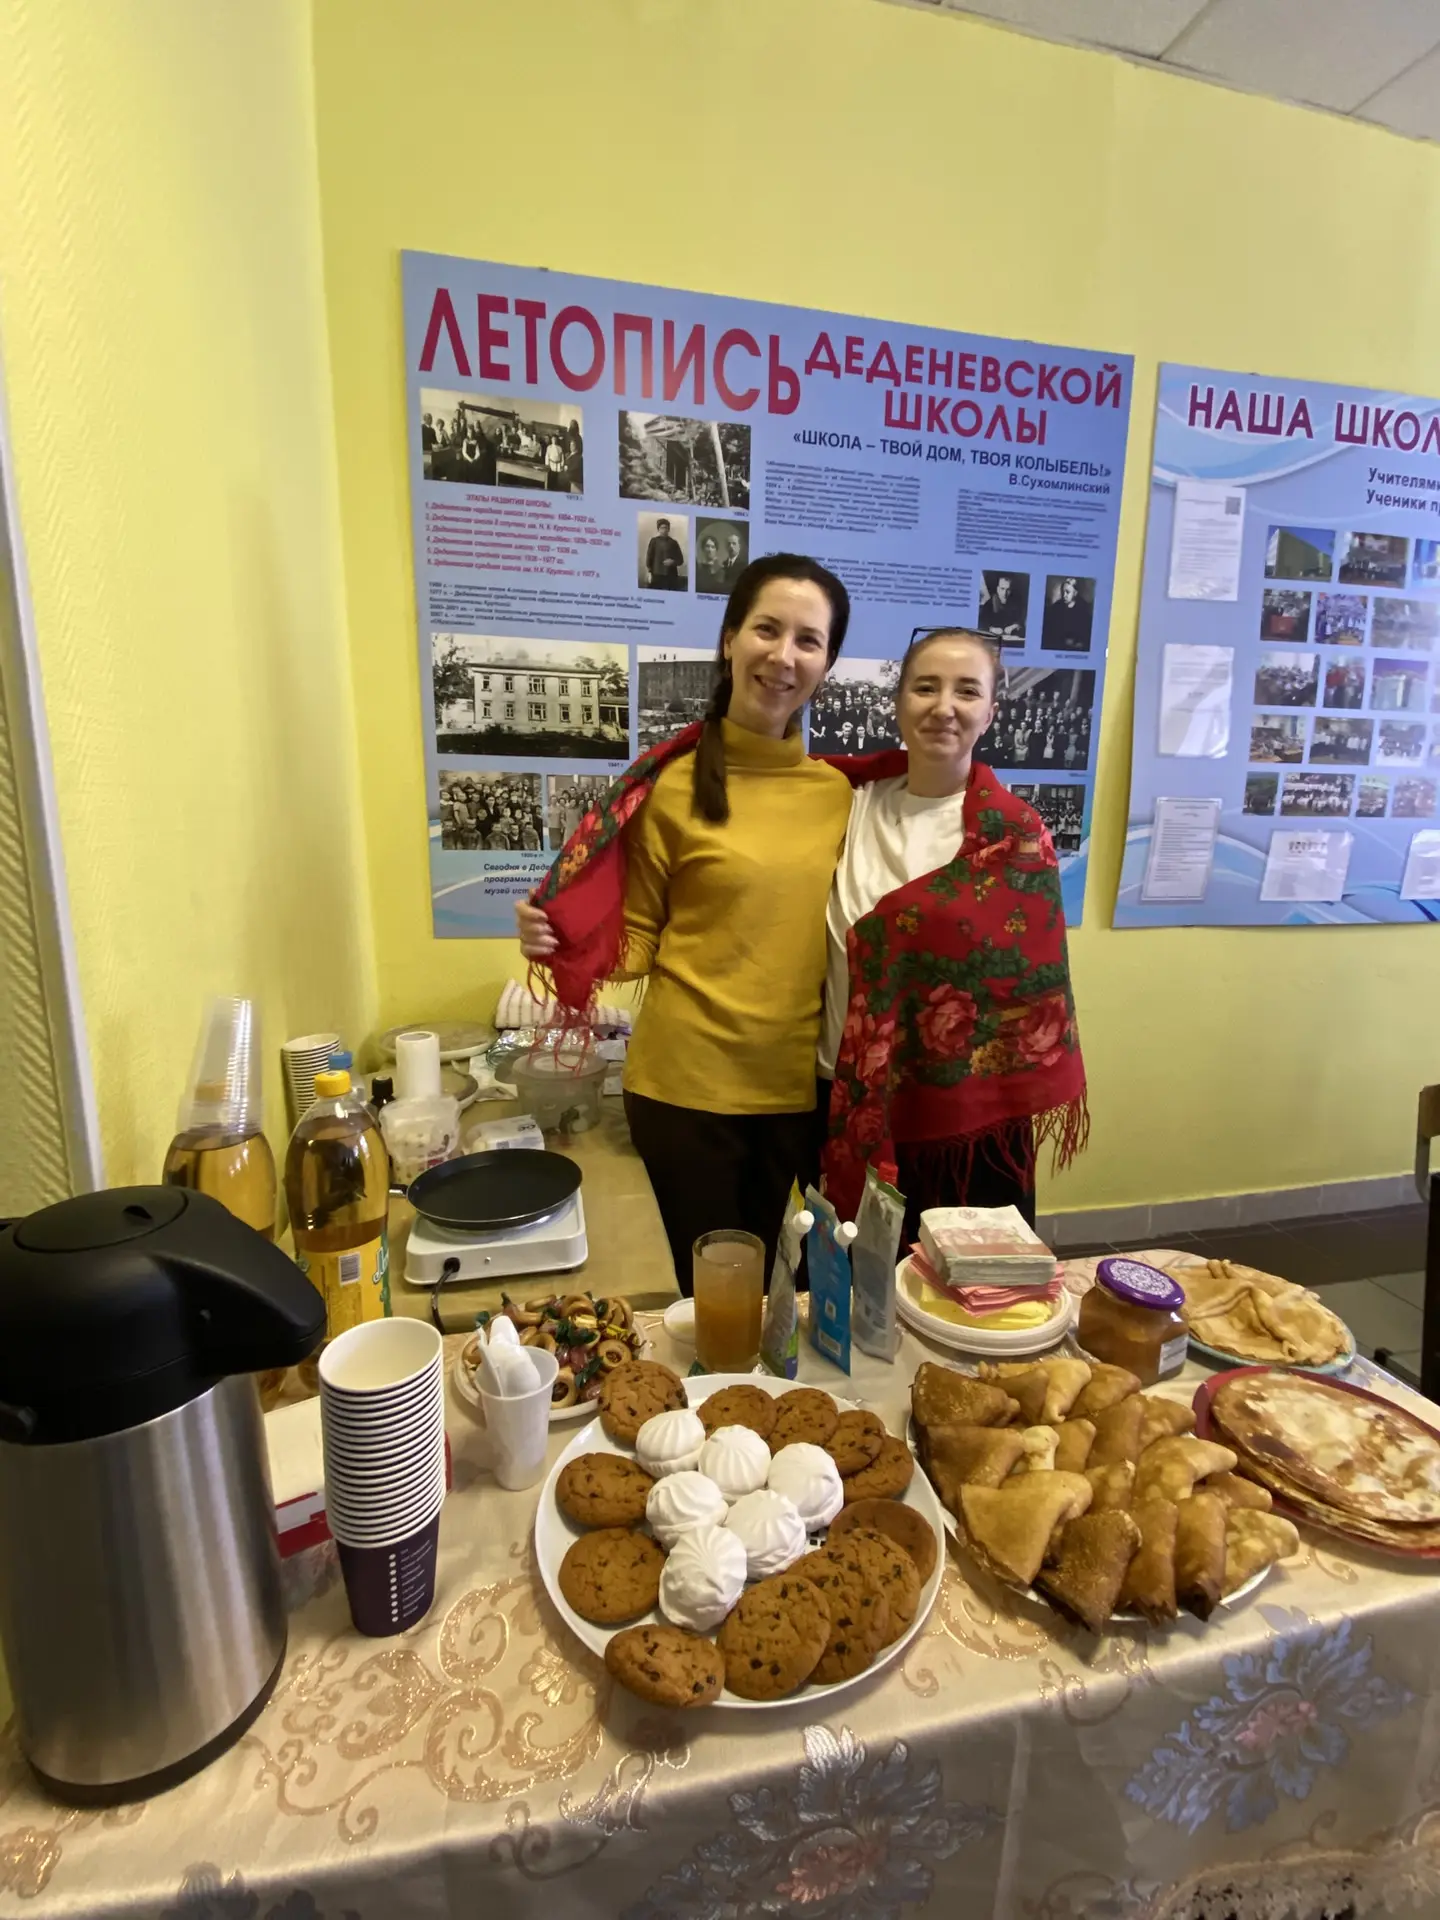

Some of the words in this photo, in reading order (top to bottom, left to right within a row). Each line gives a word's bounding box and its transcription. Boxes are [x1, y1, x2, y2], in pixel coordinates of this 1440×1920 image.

[418, 287, 801, 414] ЛЕТОПИСЬ
[804, 331, 1122, 409] ДЕДЕНЕВСКОЙ
[884, 389, 1048, 446] ШКОЛЫ
[1188, 384, 1314, 440] НАША
[792, 429, 862, 451] «ШКОЛА
[880, 438, 923, 457] ТВОЙ
[926, 444, 966, 464] ДОМ,
[970, 449, 1011, 468] ТВОЯ
[1015, 455, 1112, 478] КОЛЫБЕЛЬ!»
[1009, 472, 1111, 495] В.Сухомлинский
[1366, 488, 1427, 511] Ученики
[483, 863, 520, 872] Сегодня
[483, 876, 532, 885] программа
[483, 887, 511, 896] музей
